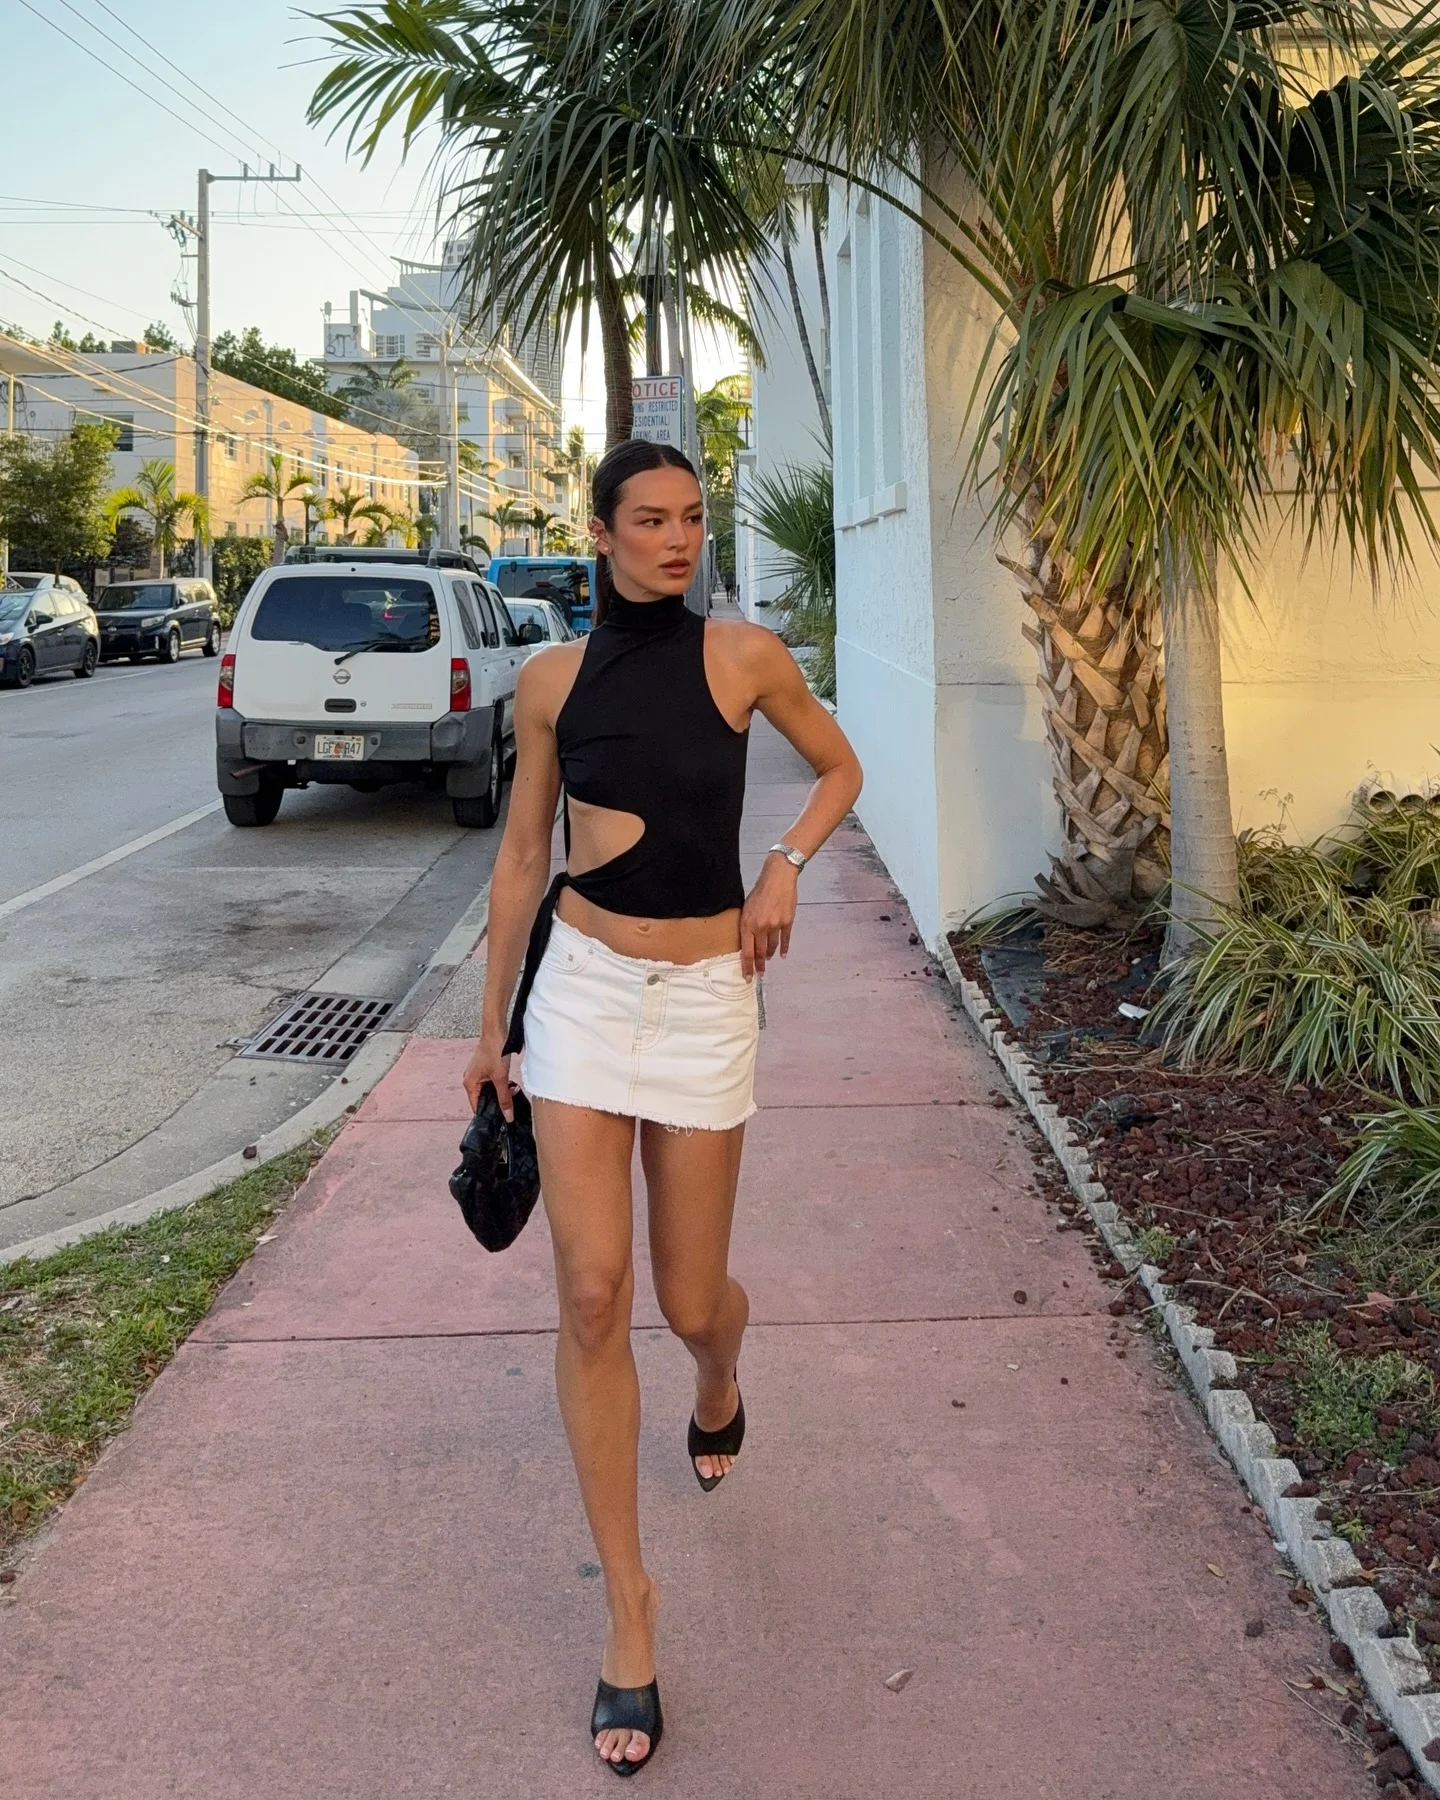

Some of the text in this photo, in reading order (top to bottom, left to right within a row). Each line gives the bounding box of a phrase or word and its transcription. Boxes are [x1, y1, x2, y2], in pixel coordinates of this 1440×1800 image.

[632, 382, 678, 397] OTICE
[649, 401, 678, 412] RESTRICTED
[634, 415, 671, 427] ESIDENTIAL)
[632, 429, 671, 440] ARKING AREA
